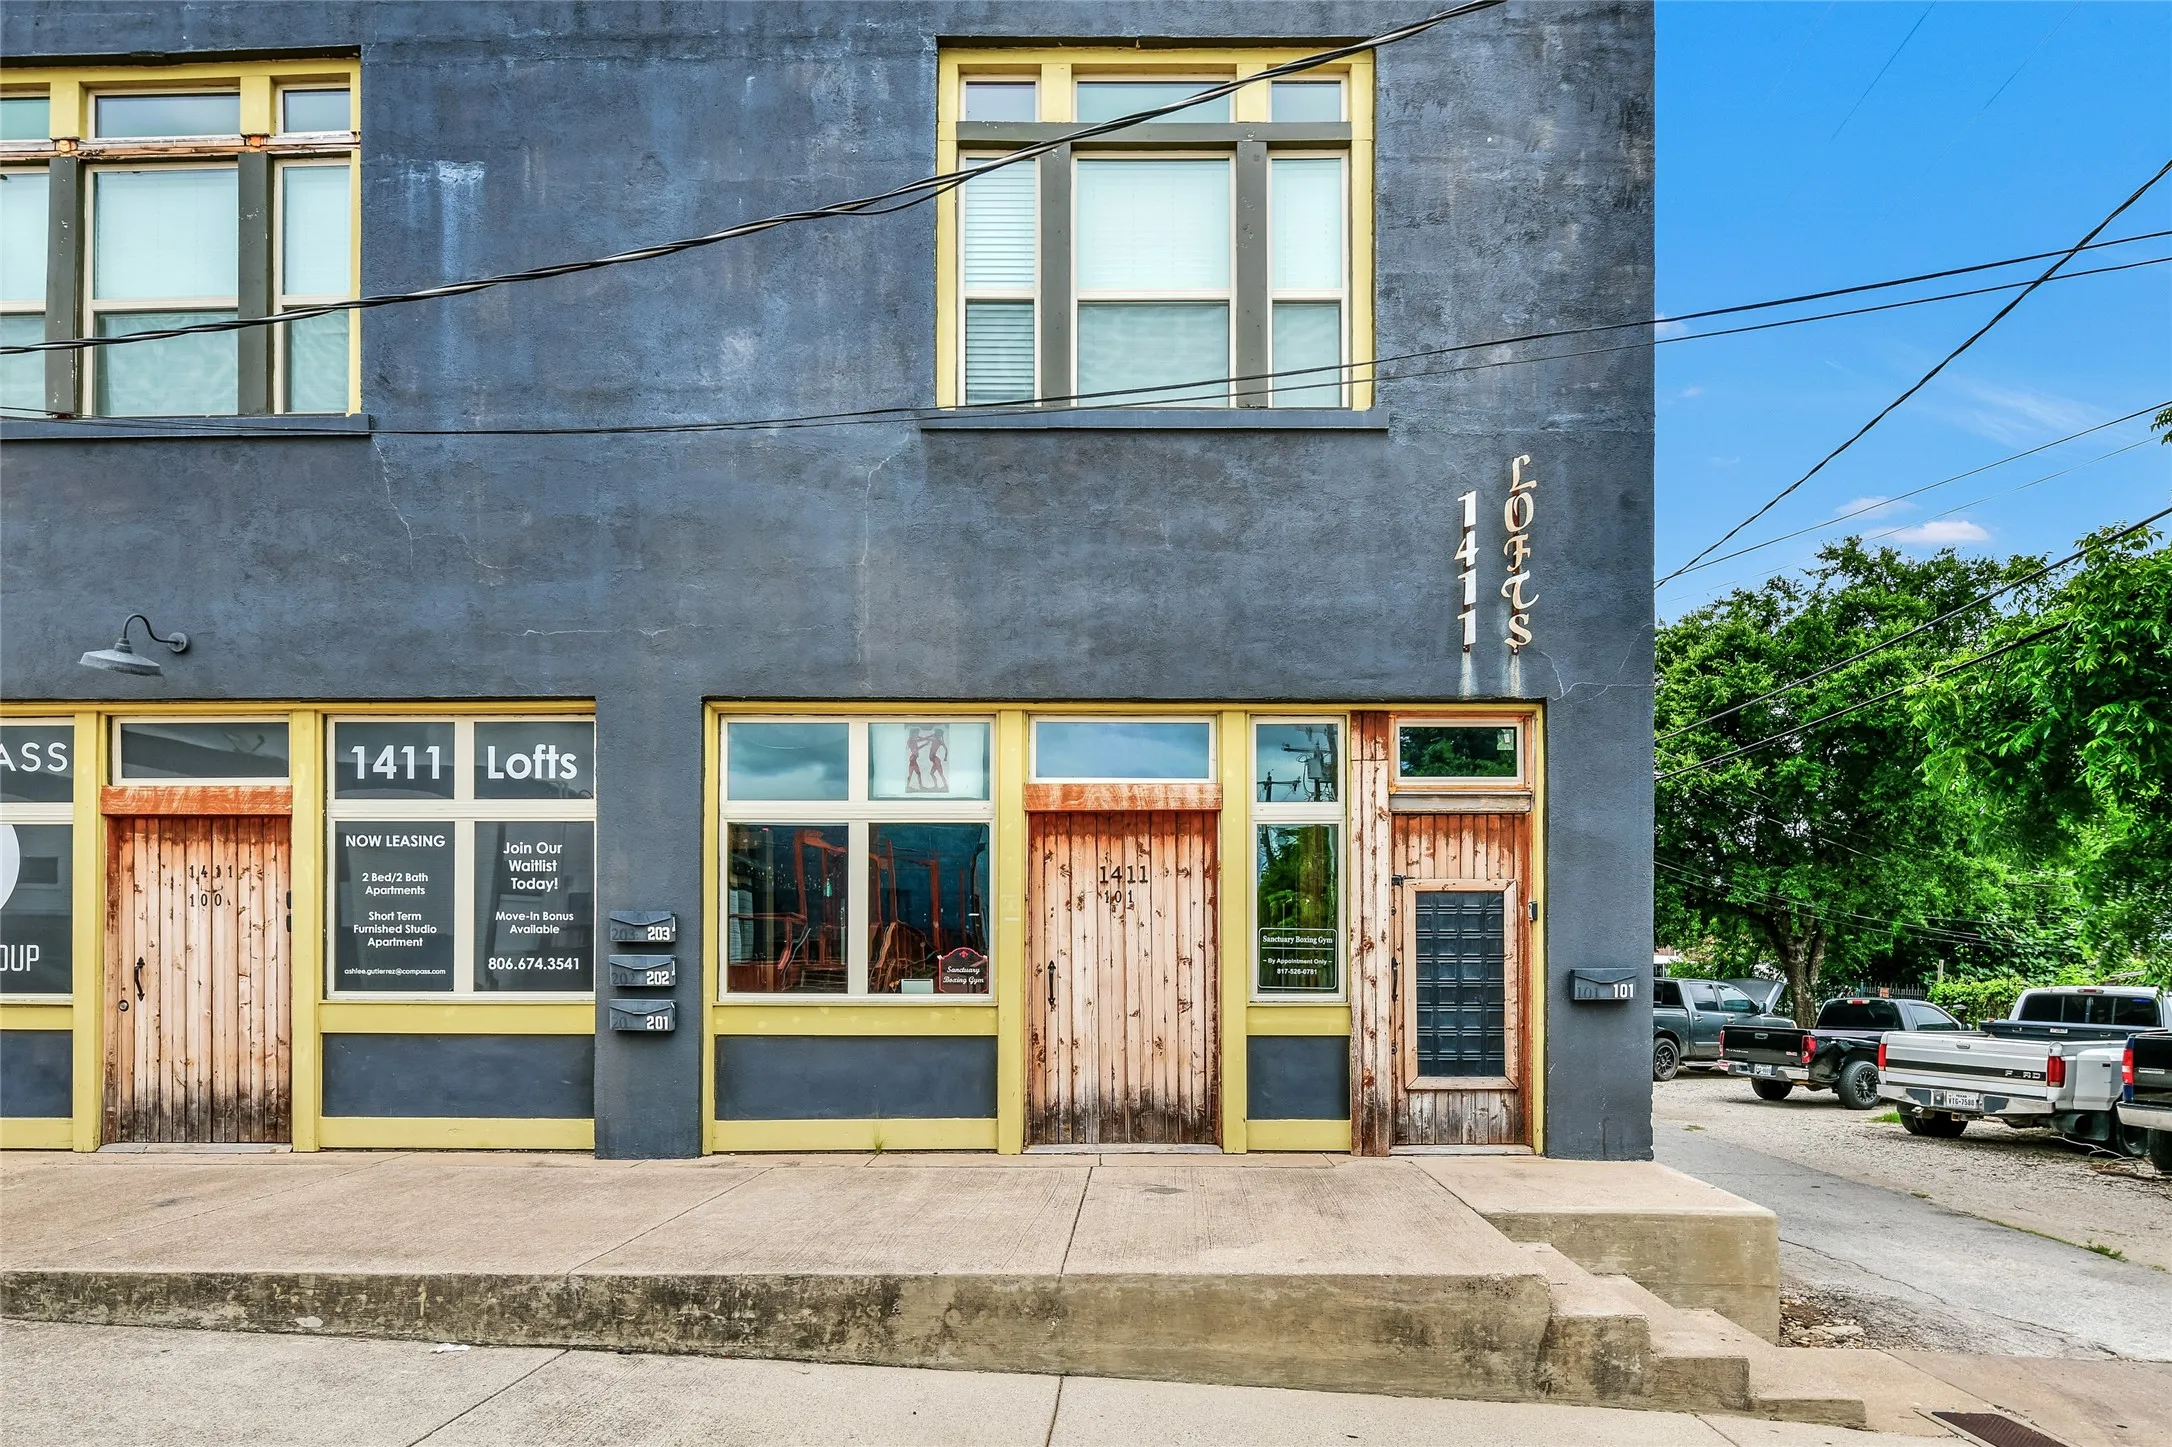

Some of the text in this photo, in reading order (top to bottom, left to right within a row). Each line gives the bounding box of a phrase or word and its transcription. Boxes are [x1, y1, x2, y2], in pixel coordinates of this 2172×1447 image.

[1454, 490, 1480, 646] 1411
[351, 743, 578, 780] 1411 Lofts
[345, 834, 446, 848] NOW LEASING
[503, 842, 563, 854] Join Our
[189, 864, 233, 878] 1411
[508, 859, 558, 872] Waitlist
[361, 872, 429, 883] 2 Bed/2 Bath
[1099, 865, 1149, 885] 1411
[511, 877, 558, 892] Today!
[365, 886, 426, 897] Apartments
[1104, 889, 1132, 904] 101
[189, 893, 222, 907] 100
[368, 911, 422, 921] Short Term
[495, 911, 574, 921] Move-In Bonus
[353, 924, 437, 934] Furnished Studio
[509, 924, 560, 934] Available
[647, 926, 671, 941] 203
[367, 937, 423, 949] Apartment
[1262, 935, 1333, 945] Sanctuary Boxing Gym
[488, 957, 580, 970] 806.674.3541
[946, 965, 980, 975] Sanctuary
[344, 967, 446, 976] ashlee.gutierrez@compass.com
[646, 970, 670, 985] 202
[942, 976, 984, 985] Boxing Gym
[1613, 983, 1634, 998] 101
[646, 1015, 669, 1030] 201
[2004, 1069, 2041, 1079] FRD
